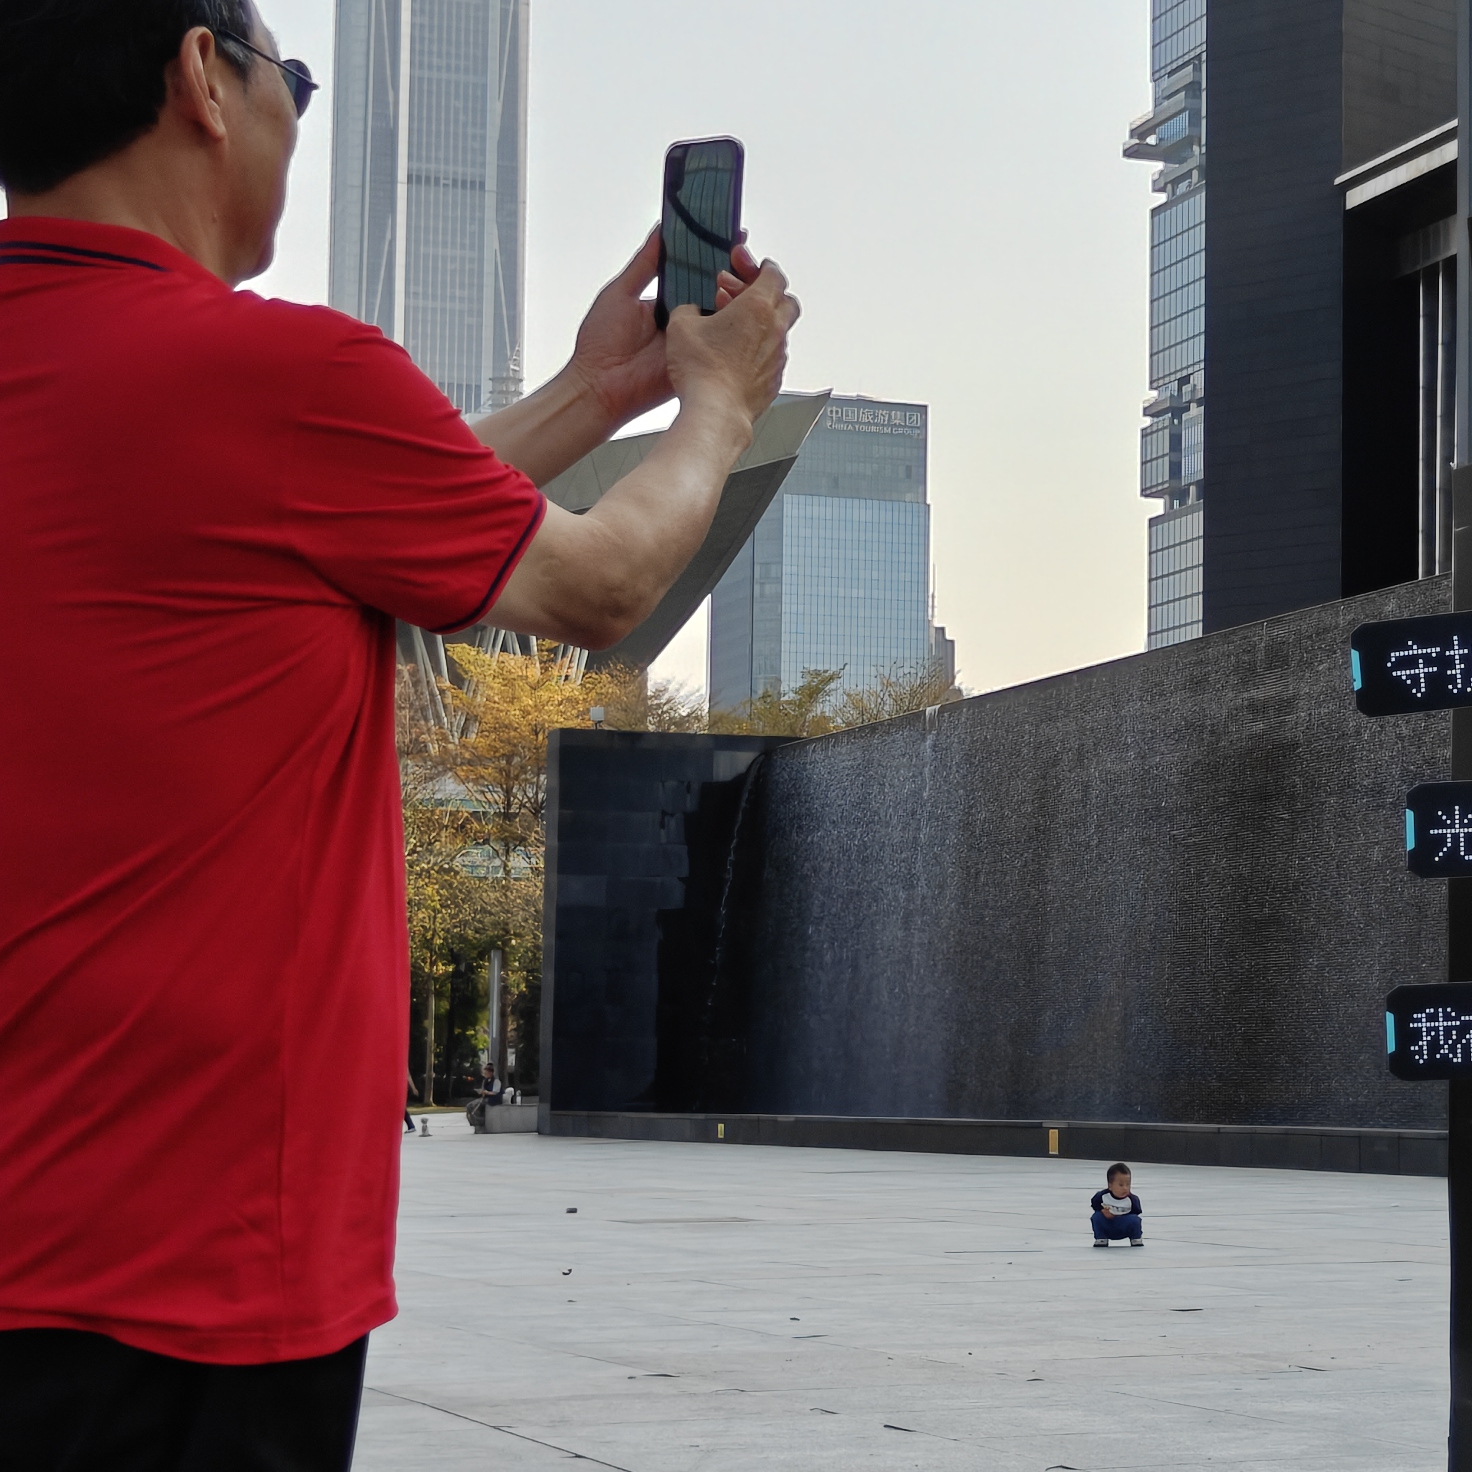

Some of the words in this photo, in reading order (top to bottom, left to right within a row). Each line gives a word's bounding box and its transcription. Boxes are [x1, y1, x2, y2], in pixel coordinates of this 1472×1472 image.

[827, 406, 921, 427] 中国旅游集团
[827, 422, 853, 431] CHINA
[855, 424, 891, 434] TOURISM
[892, 427, 921, 437] GROUP
